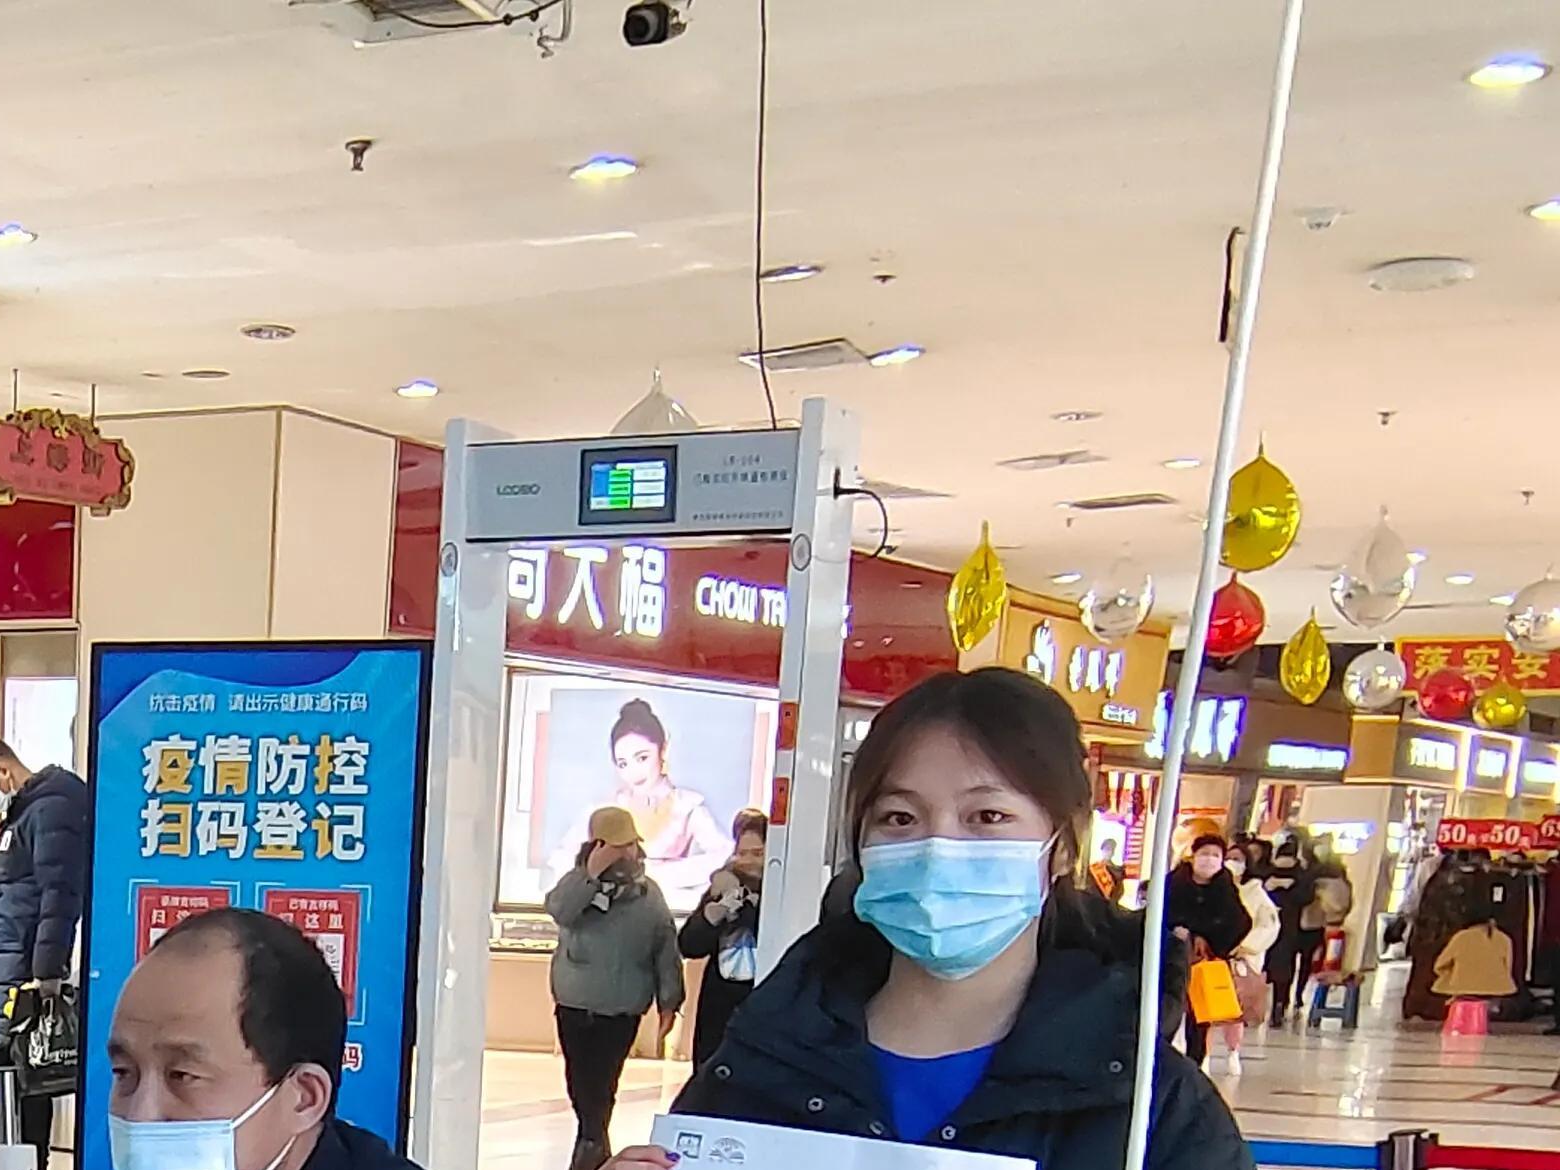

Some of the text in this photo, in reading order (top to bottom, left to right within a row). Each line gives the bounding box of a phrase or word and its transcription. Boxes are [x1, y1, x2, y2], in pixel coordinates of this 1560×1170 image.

[695, 577, 757, 623] CHOW
[149, 693, 368, 712] 抗击疫情 请出示健康通行码
[142, 734, 370, 794] 疫情防控
[140, 799, 366, 861] 扫码登记
